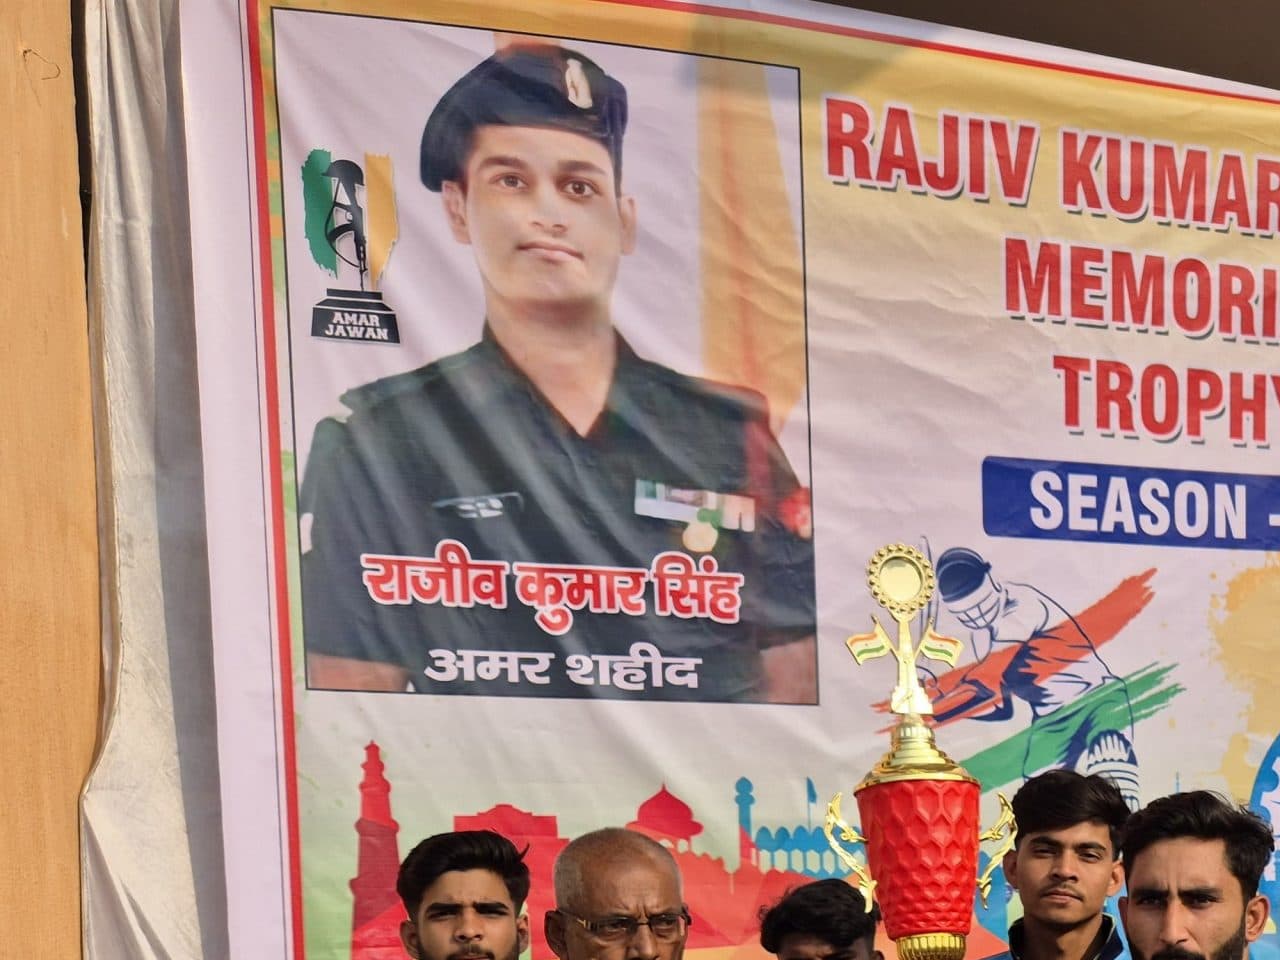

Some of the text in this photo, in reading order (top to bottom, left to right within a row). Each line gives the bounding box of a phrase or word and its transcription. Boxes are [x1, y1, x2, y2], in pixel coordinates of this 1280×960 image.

[825, 98, 1038, 203] RAJIV
[324, 324, 389, 340] JAWAN
[332, 311, 380, 327] AMAR
[1029, 470, 1247, 540] SEASON
[361, 540, 744, 635] राजीव कुमार सिंह
[424, 641, 703, 691] अमर शहीद
